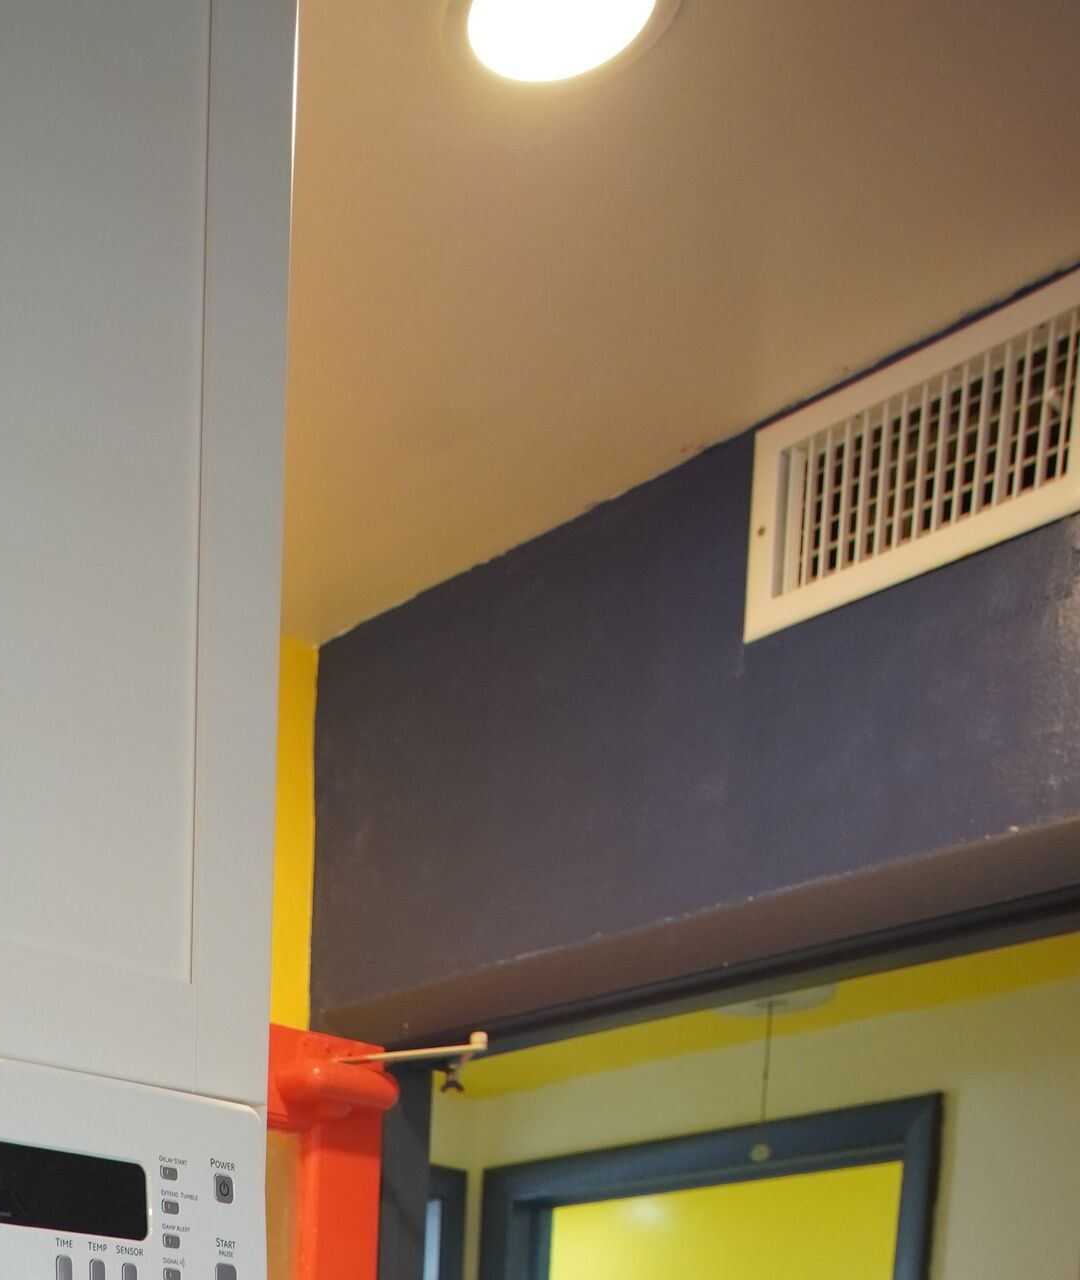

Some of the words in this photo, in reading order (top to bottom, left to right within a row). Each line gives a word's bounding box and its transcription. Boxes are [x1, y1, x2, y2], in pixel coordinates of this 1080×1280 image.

[174, 1158, 188, 1166] START
[210, 1157, 235, 1171] POWER
[161, 1189, 179, 1198] EXTEND
[180, 1192, 199, 1201] TUMBLE
[162, 1223, 176, 1231] DAMP
[177, 1225, 190, 1233] ALERT
[55, 1237, 73, 1248] TIME
[88, 1241, 108, 1252] TEMP
[216, 1237, 236, 1249] START
[115, 1245, 144, 1256] SENSOR
[218, 1250, 234, 1258] PAUSE
[162, 1257, 179, 1265] SIGNAL
